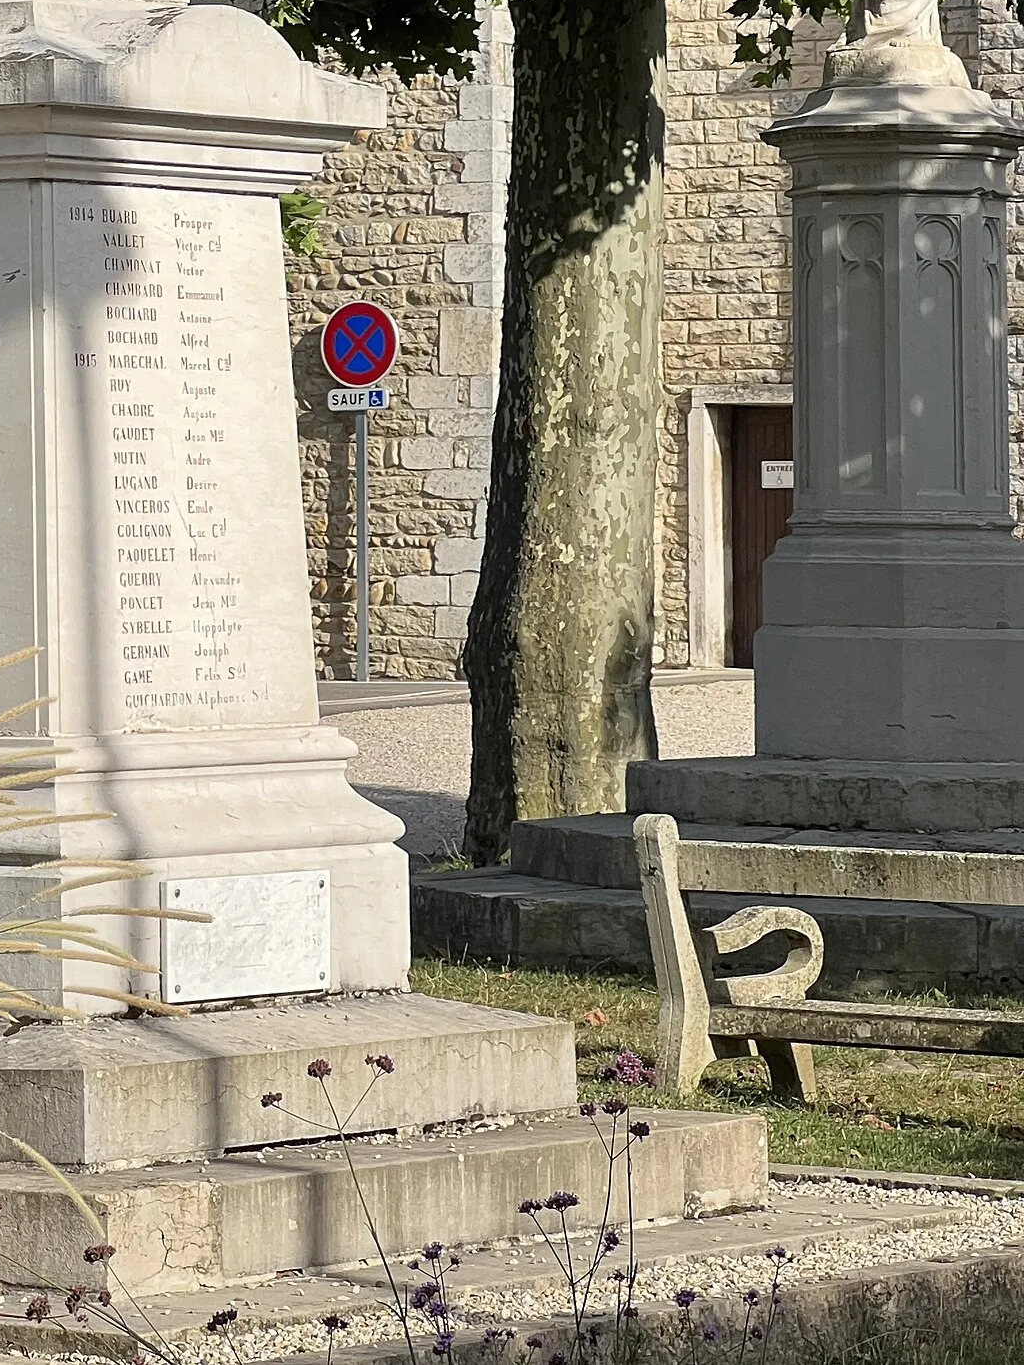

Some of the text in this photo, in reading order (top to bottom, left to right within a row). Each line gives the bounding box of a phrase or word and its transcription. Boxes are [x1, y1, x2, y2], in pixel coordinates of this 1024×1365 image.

[69, 206, 213, 234] 1914 BUARD Prosper
[175, 238, 204, 252] Victor
[176, 261, 205, 277] Victor
[105, 281, 163, 298] CHAMBARD
[106, 306, 157, 322] BOCHARD
[107, 330, 209, 351] BOCHARD Alfred
[75, 352, 97, 368] 1915
[109, 354, 167, 370] MARECHAL
[180, 356, 211, 371] Marcel
[110, 378, 216, 399] RUY Auguste
[332, 394, 365, 405] SAUF
[113, 427, 155, 442] GAUDET
[184, 429, 206, 442] Jean
[113, 451, 147, 465] MUTIN
[119, 572, 162, 586] GUERRY
[121, 620, 173, 635] SYBELLE
[123, 645, 170, 660] GERMAIN
